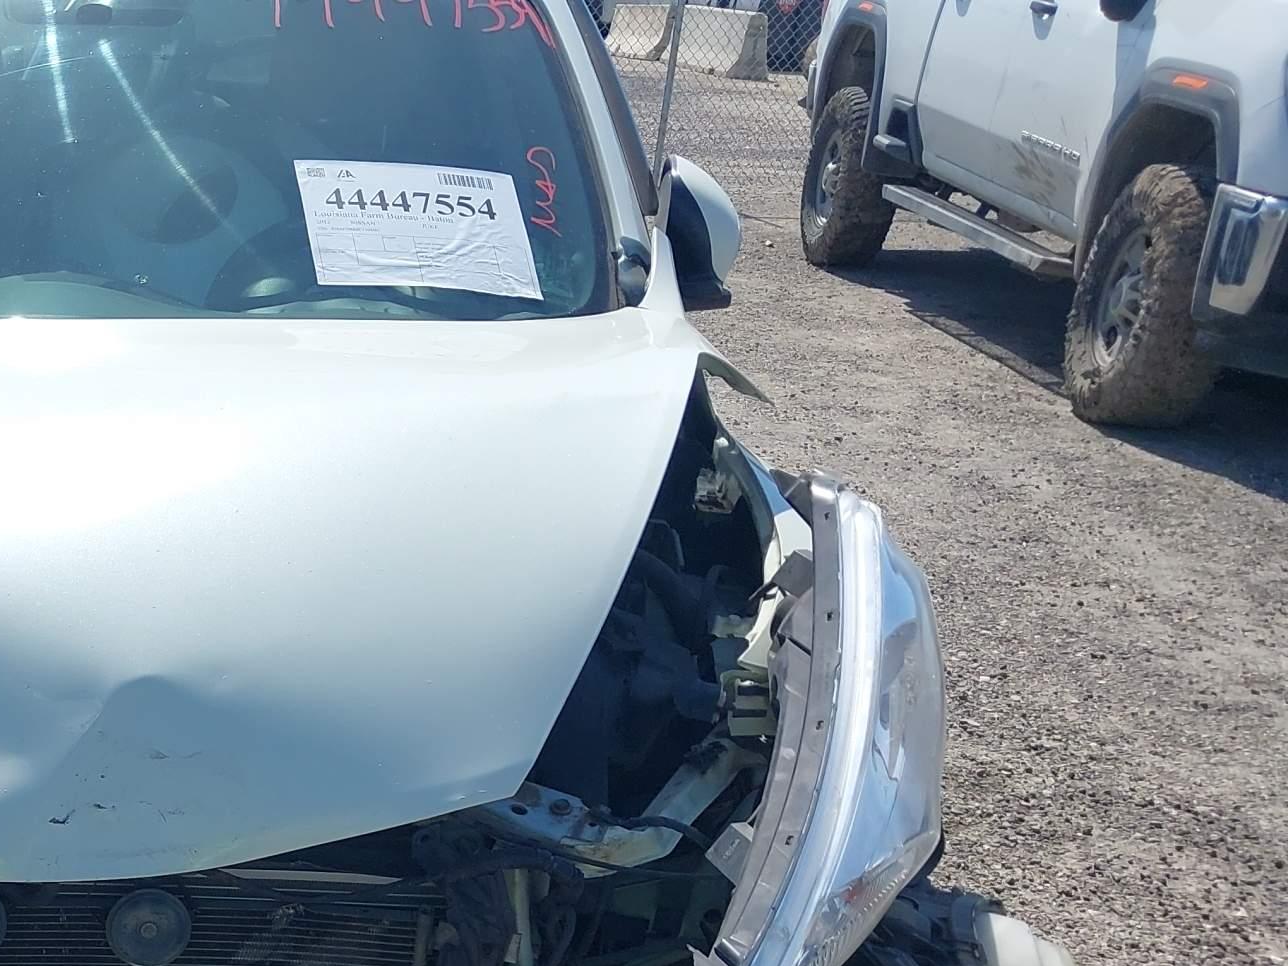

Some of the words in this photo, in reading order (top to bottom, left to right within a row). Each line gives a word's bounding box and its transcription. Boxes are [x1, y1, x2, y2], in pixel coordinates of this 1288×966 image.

[325, 187, 497, 220] 44447554
[361, 211, 384, 219] Farm
[387, 212, 419, 222] Bureau
